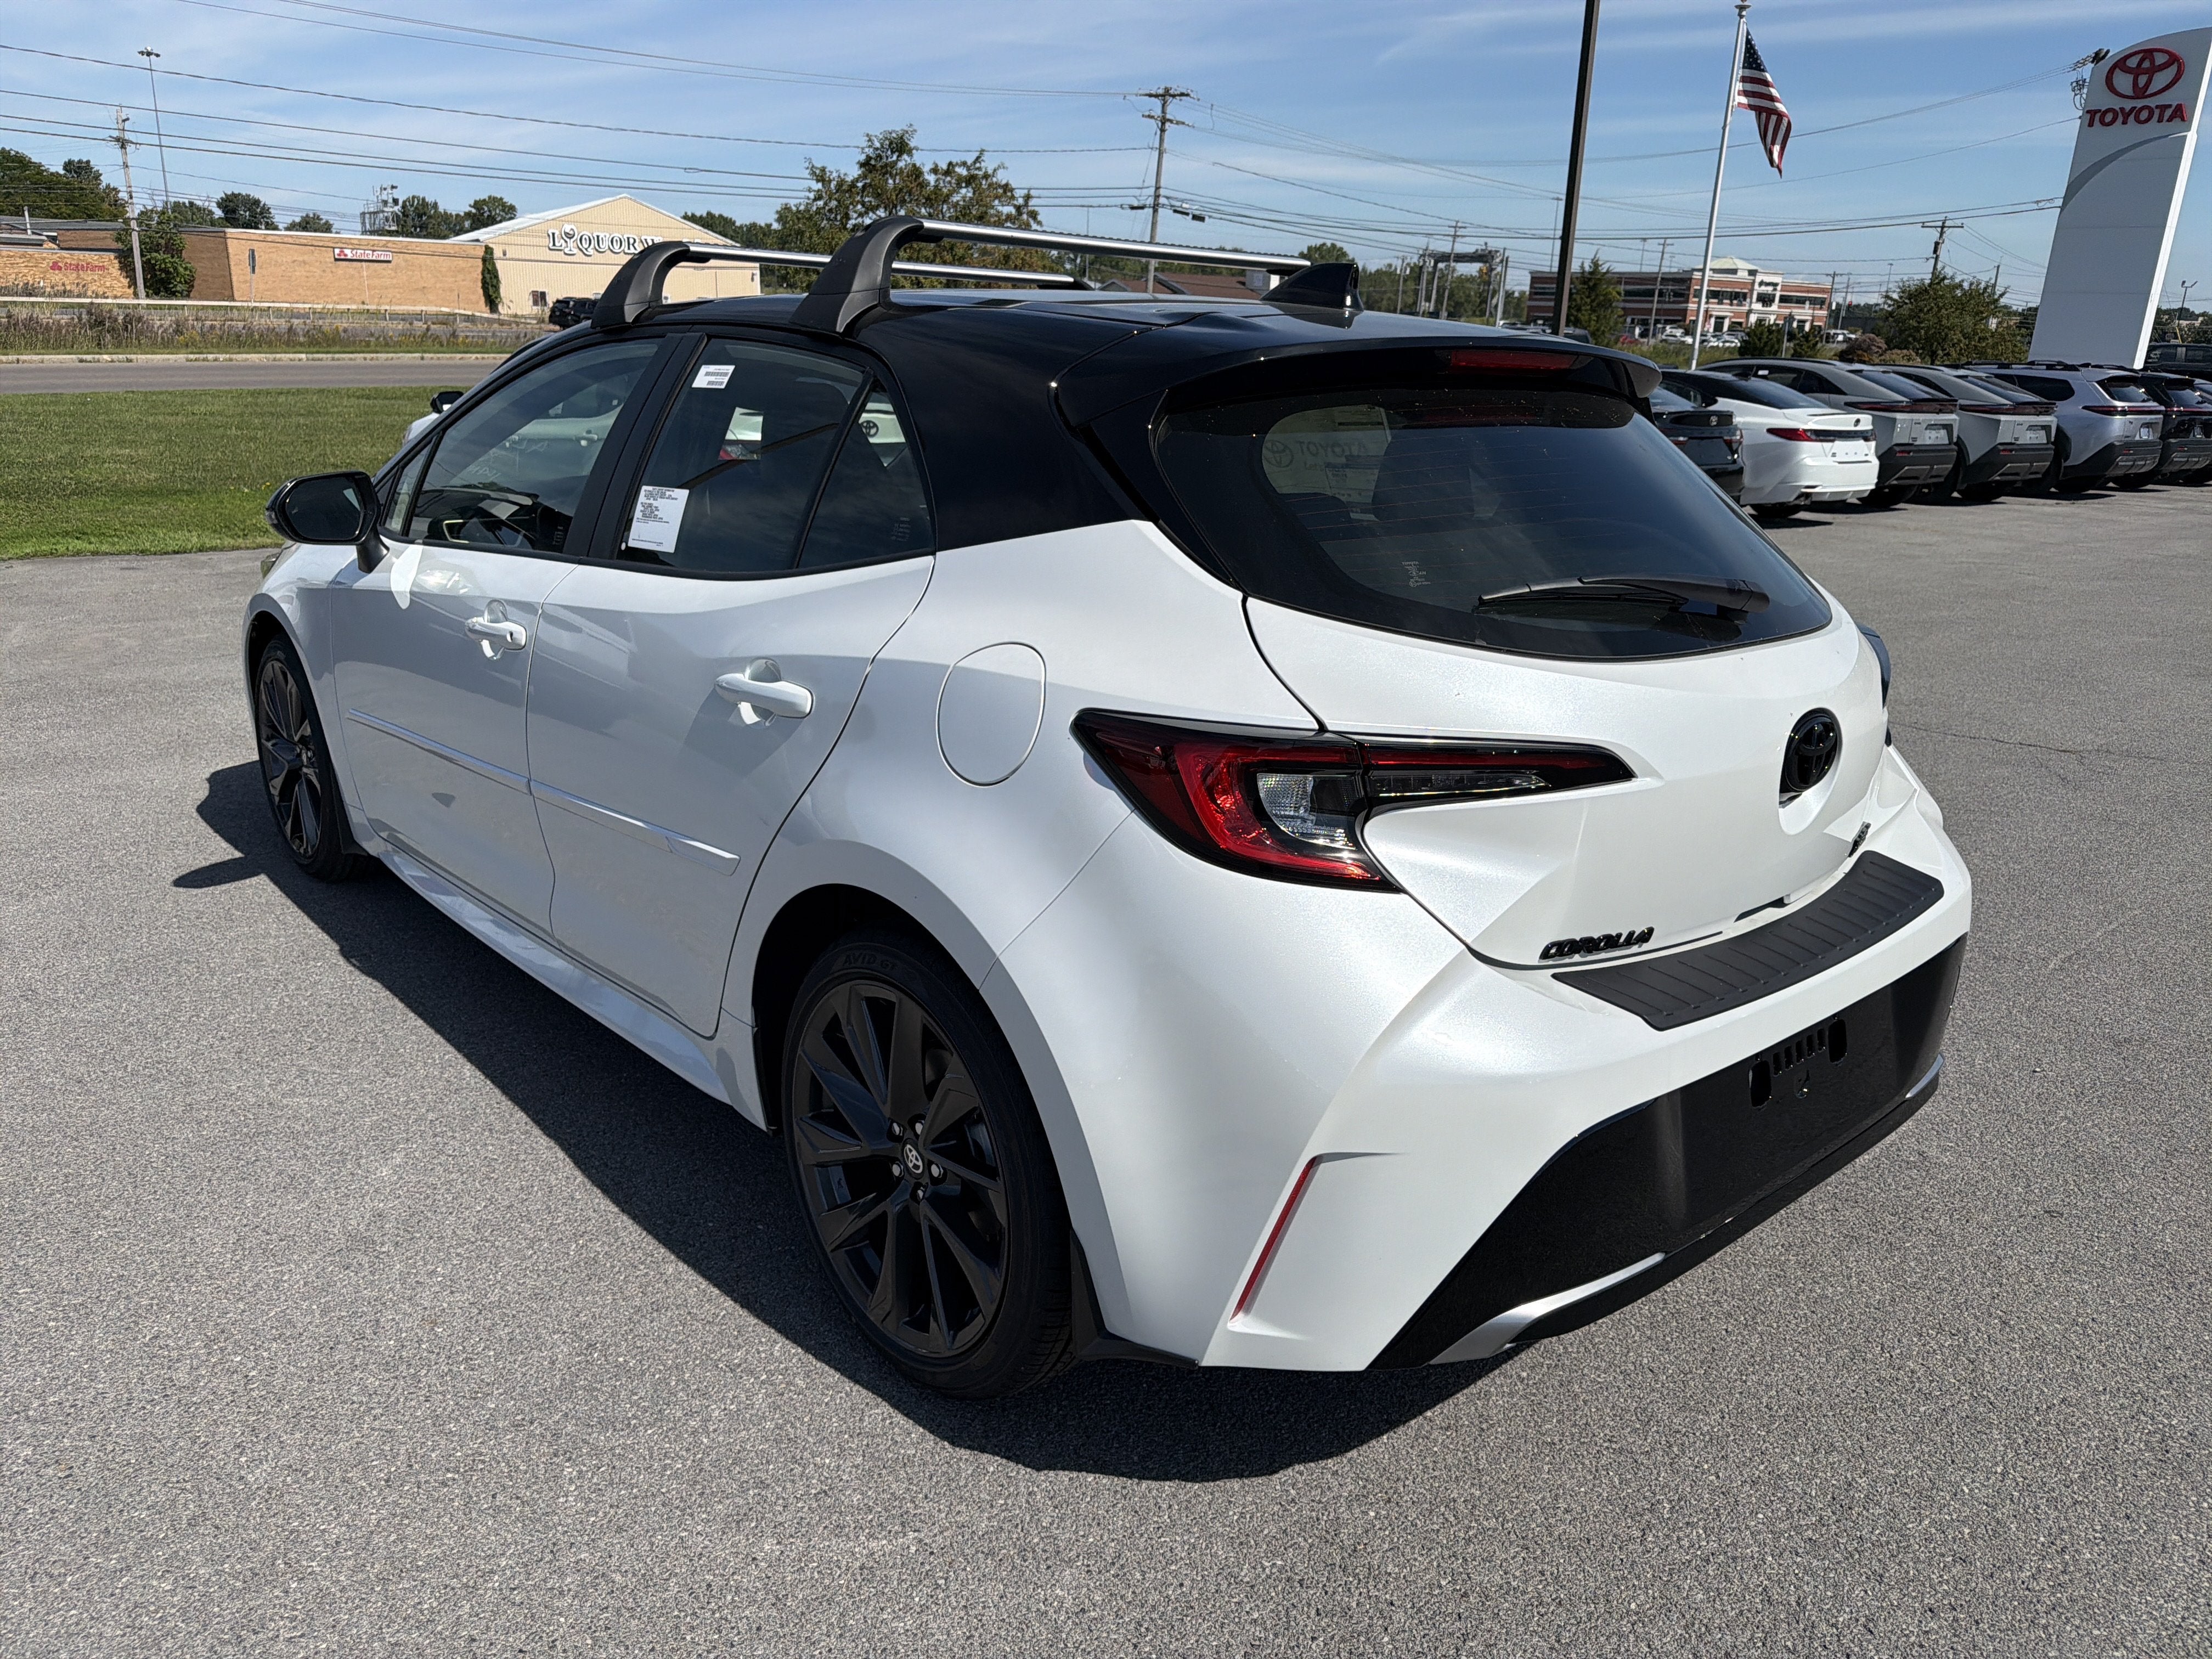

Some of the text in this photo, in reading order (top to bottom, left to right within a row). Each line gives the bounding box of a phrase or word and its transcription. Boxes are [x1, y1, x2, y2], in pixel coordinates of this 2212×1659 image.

[2086, 103, 2187, 127] TOYOTA
[1538, 926, 1655, 960] COROLLA
[843, 952, 878, 966] AVID
